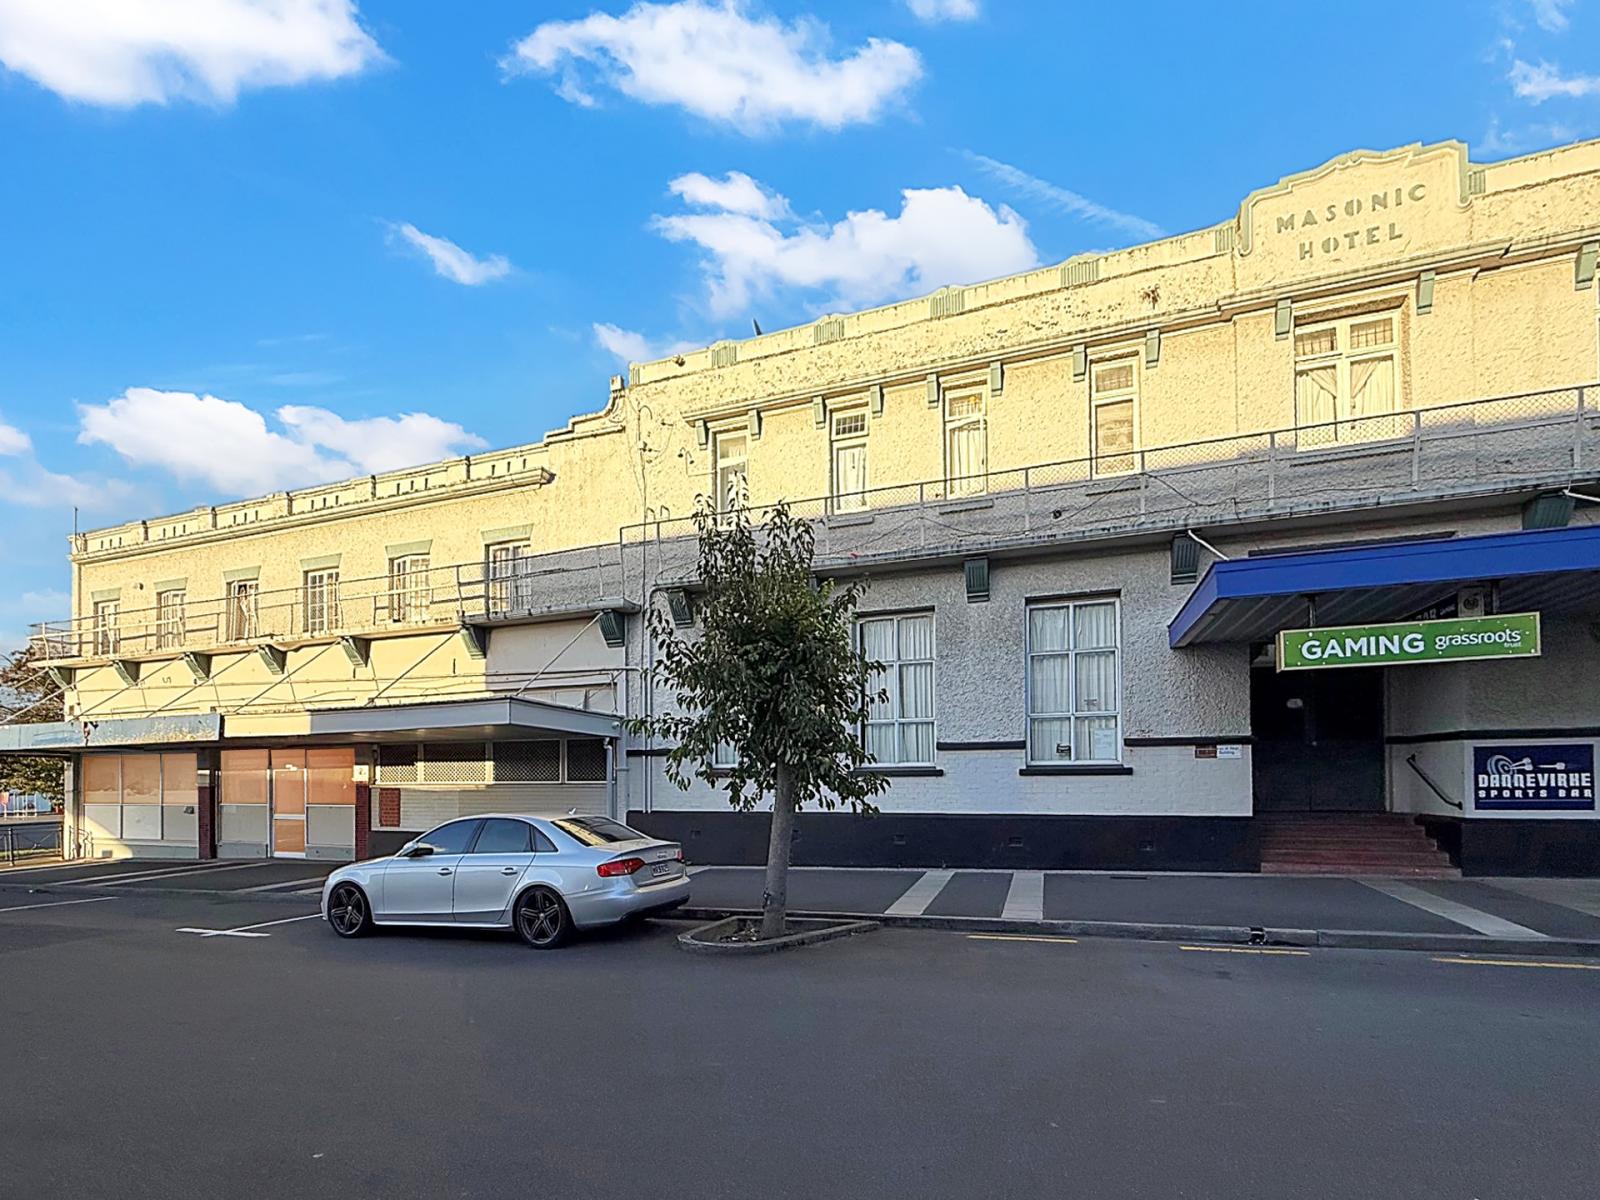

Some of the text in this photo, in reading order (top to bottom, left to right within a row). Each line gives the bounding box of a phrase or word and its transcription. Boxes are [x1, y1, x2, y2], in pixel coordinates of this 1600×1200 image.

[1276, 184, 1426, 233] MASONIC
[1299, 222, 1403, 260] HOTEL
[1301, 629, 1521, 660] GAMING grassroots
[1478, 773, 1591, 788] DANNEVIRKE
[1478, 789, 1592, 798] SPORTS BAR
